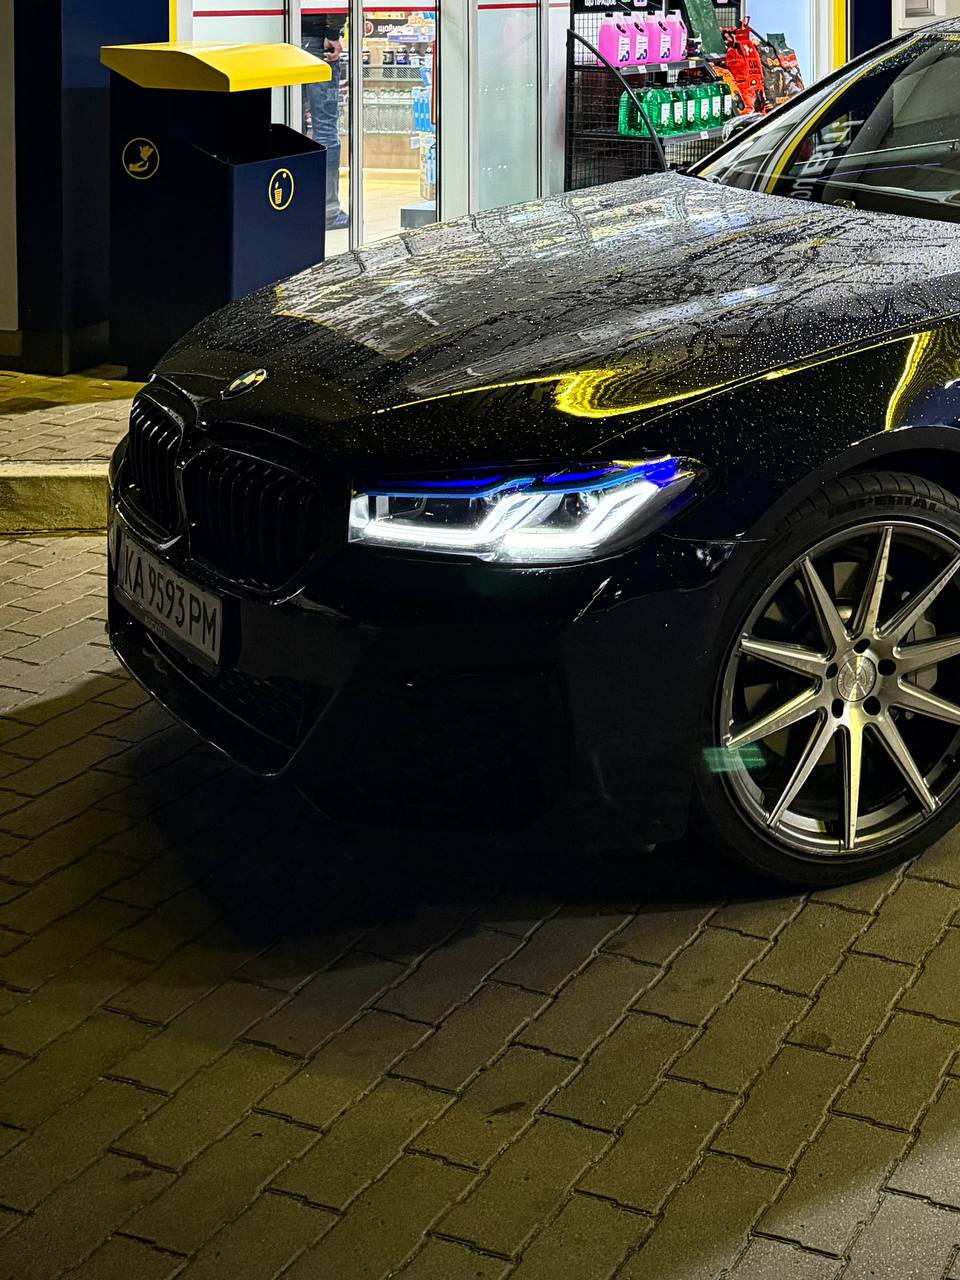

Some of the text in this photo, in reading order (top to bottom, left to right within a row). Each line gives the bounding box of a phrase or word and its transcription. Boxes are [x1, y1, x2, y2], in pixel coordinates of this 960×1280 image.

[125, 545, 217, 652] KA 9593 PM
